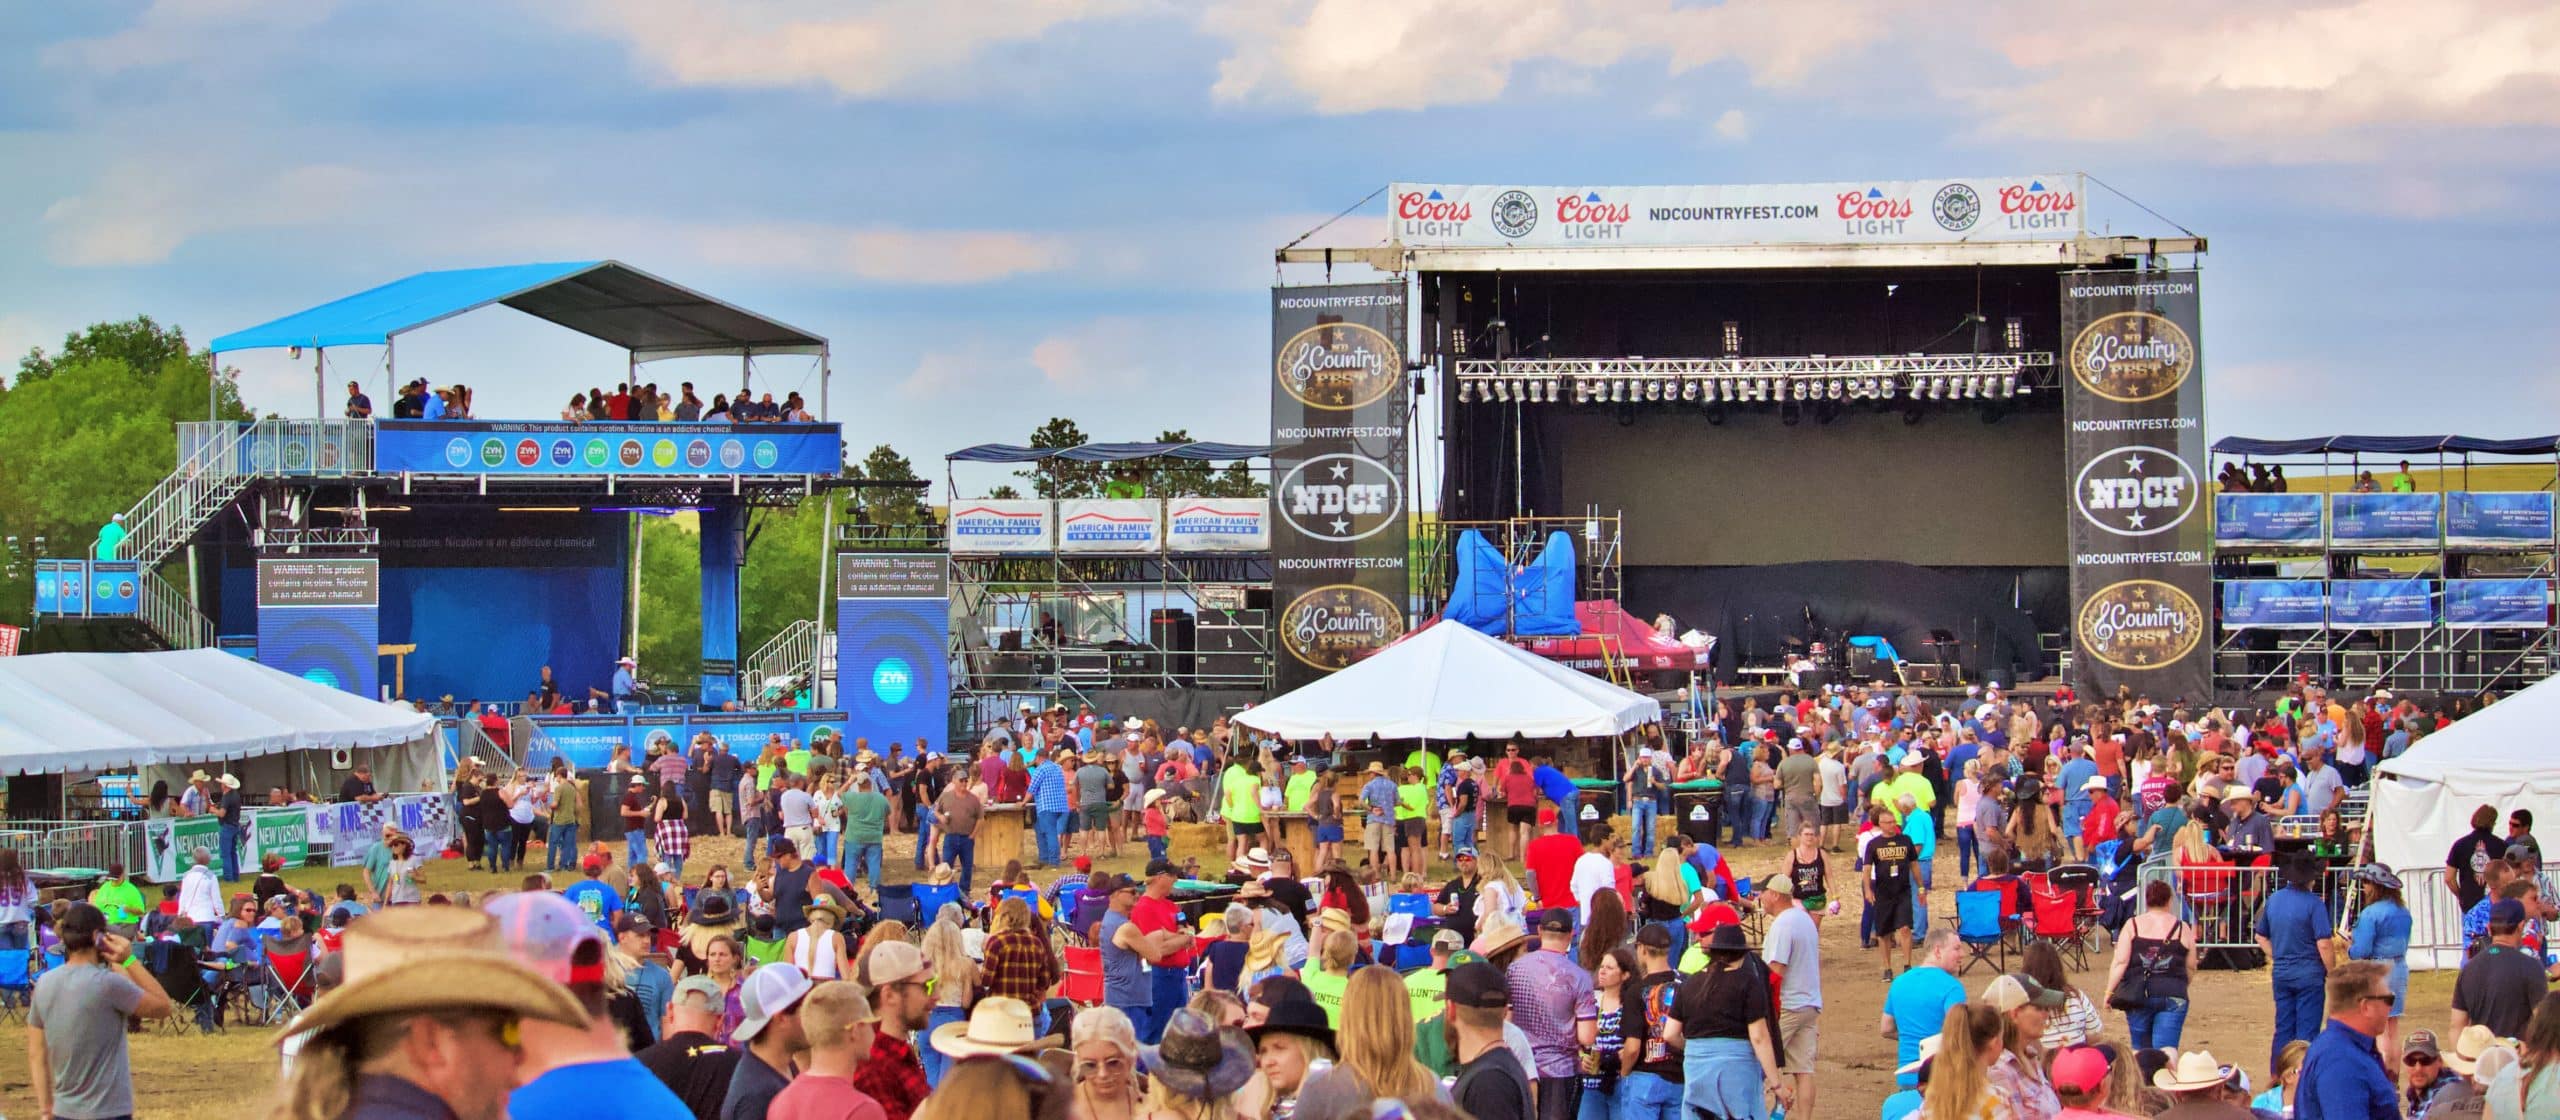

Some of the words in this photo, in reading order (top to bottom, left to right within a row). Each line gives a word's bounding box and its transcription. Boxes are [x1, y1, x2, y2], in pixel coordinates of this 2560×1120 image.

[1496, 193, 1532, 208] DAKOTA
[1938, 186, 1973, 202] DAKOTA
[1999, 184, 2076, 214] Coors
[1398, 192, 1472, 221] Coors
[1556, 194, 1631, 224] Coors
[1836, 190, 1913, 220] Coors
[1649, 205, 1818, 221] NDCOUNTRYFEST.COM
[1496, 221, 1532, 234] APPAREL
[1845, 220, 1906, 235] LIGHT
[1938, 214, 1976, 228] APPAREL
[2008, 213, 2069, 230] LIGHT
[1405, 221, 1464, 236] LIGHT
[1564, 224, 1624, 239] LIGHT
[2069, 283, 2193, 298] NDCOUNTRYFEST.COM
[1280, 295, 1402, 308] NDCOUNTRYFEST.COM
[2103, 335, 2176, 367] Country
[1309, 345, 1382, 376] Country
[2109, 362, 2162, 379] FEST
[1314, 372, 1369, 387] FEST
[491, 424, 528, 432] WARNING:
[528, 424, 542, 432] This
[544, 424, 569, 434] product
[570, 425, 597, 433] contains
[599, 424, 626, 433] nicotine.
[628, 425, 655, 433] Nicotine
[656, 425, 662, 433] is
[672, 425, 701, 433] addictive
[702, 425, 732, 434] chemical.
[2072, 418, 2197, 432] NDCOUNTRYFEST.COM
[1277, 426, 1402, 439] NDCOUNTRYFEST.COM
[485, 446, 502, 455] ZYN
[520, 446, 536, 455] ZYN
[554, 446, 571, 455] ZYN
[588, 446, 604, 455] ZYN
[623, 448, 640, 456] ZYN
[690, 448, 707, 456] ZYN
[1292, 484, 1389, 515] NDCF
[2088, 476, 2185, 510] NDCF
[957, 518, 1005, 527] AMERICAN
[1008, 518, 1041, 527] FAMILY
[1067, 524, 1115, 533] AMERICAN
[1118, 523, 1152, 532] FAMILY
[1175, 517, 1222, 526] AMERICAN
[1225, 517, 1259, 526] FAMILY
[1072, 532, 1145, 540] INSURANCE
[1179, 526, 1253, 534] INSURANCE
[892, 558, 907, 568] This
[908, 560, 936, 568] product
[1278, 557, 1404, 569] NDCOUNTRYFEST.COM
[2077, 552, 2201, 565] NDCOUNTRYFEST.COM
[273, 565, 316, 574] WARNING:
[317, 565, 333, 574] This
[334, 565, 365, 575] product
[848, 572, 878, 580] contains
[910, 571, 940, 580] Nicotine
[268, 578, 301, 588] contains
[336, 578, 368, 587] Nicotine
[1313, 606, 1386, 638] Country
[2110, 603, 2185, 634] Country
[1318, 634, 1371, 649] FEST
[2116, 630, 2171, 646] FEST
[880, 671, 908, 684] ZYN
[560, 736, 624, 744] TOBACCO-FREE
[728, 732, 790, 742] TOBACCO-EE
[258, 827, 276, 843] NEW
[278, 824, 306, 842] VISION
[176, 834, 194, 851] NEW
[194, 831, 220, 849] VISIO
